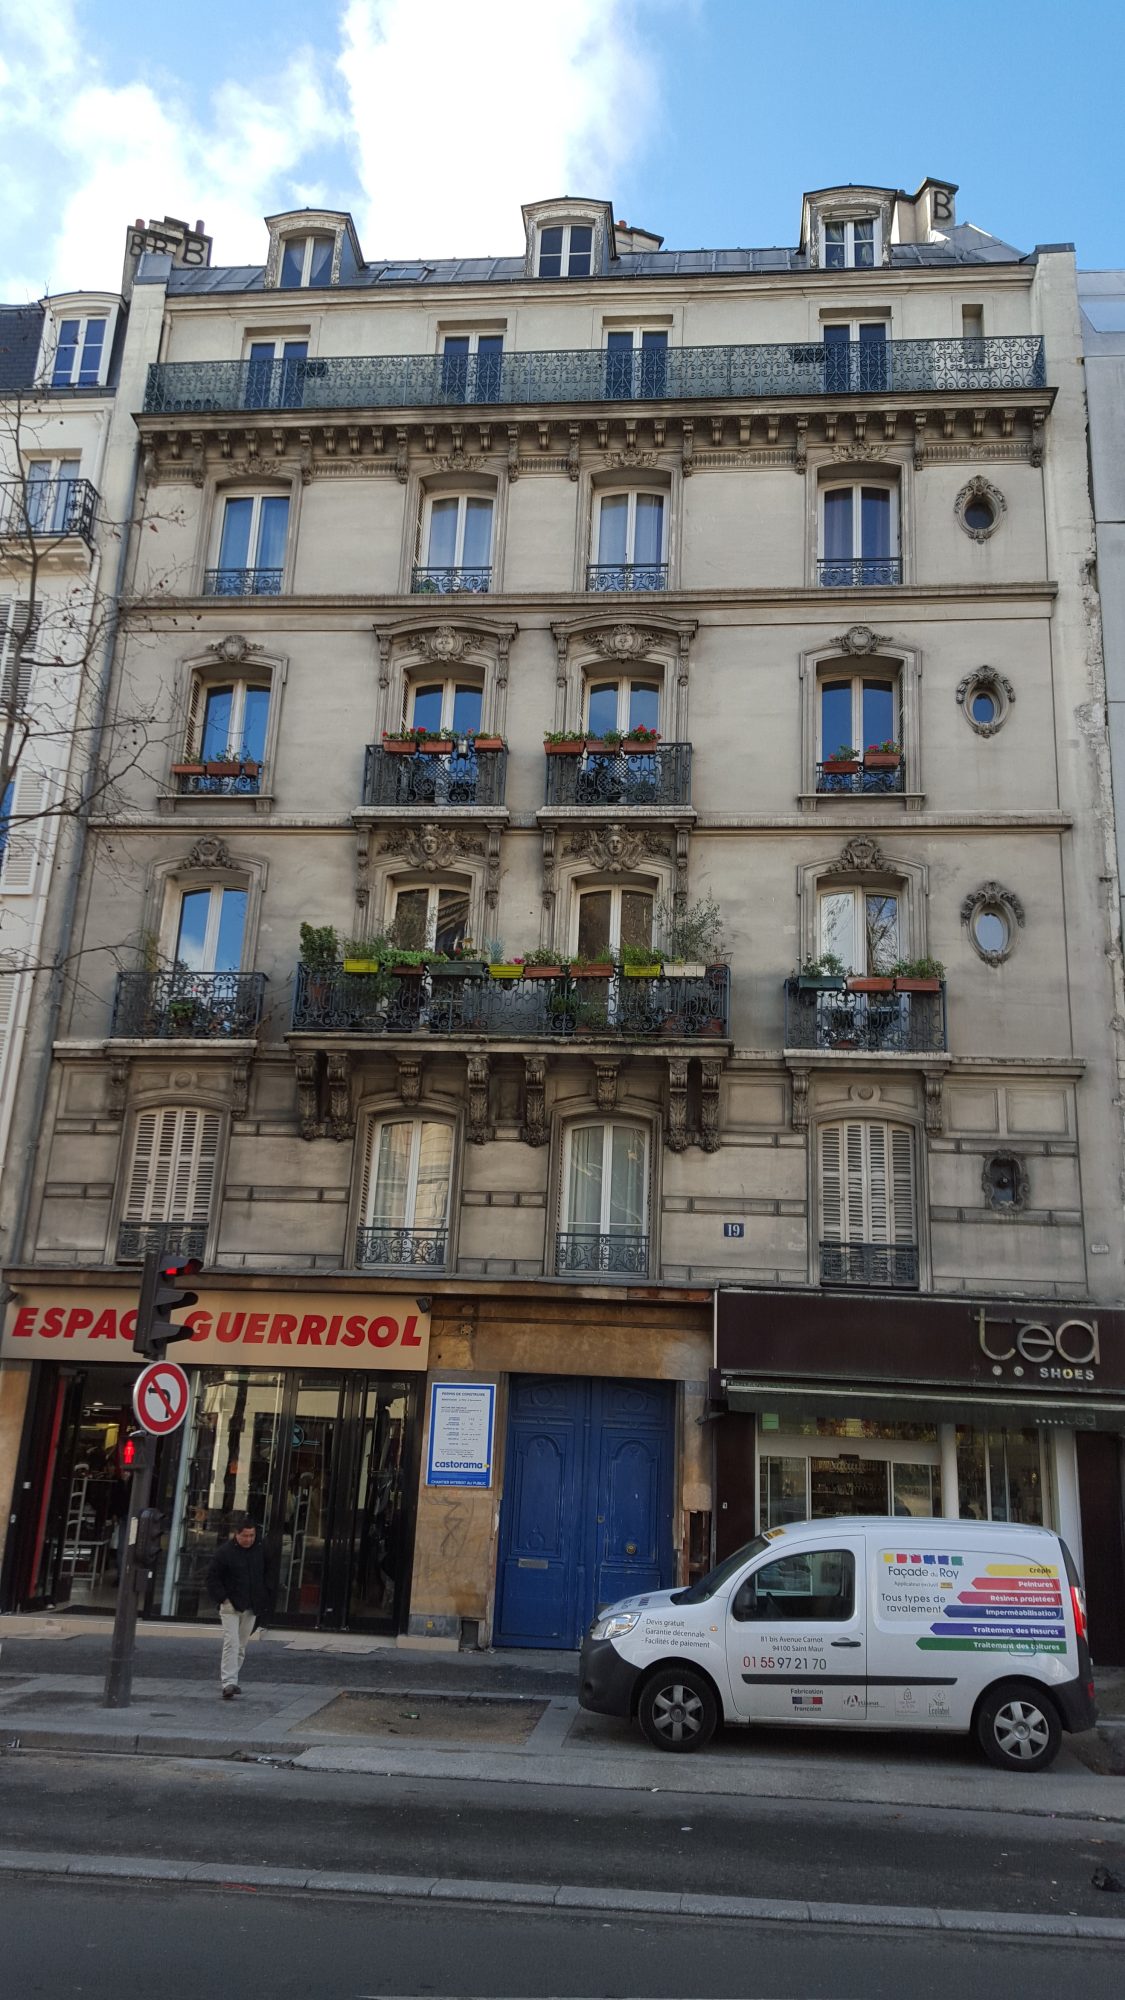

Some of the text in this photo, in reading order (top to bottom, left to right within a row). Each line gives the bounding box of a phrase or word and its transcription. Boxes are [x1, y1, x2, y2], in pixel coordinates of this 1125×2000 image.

[727, 1224, 740, 1237] 19
[12, 1307, 422, 1347] ESPAC GUERRISOL
[974, 1308, 1100, 1365] tea
[1039, 1367, 1095, 1381] SHOES
[435, 1461, 483, 1469] castorama
[888, 1566, 929, 1578] Façade
[939, 1568, 960, 1580] Roy
[1018, 1580, 1054, 1588] Peintures
[881, 1593, 946, 1604] Tous types de
[990, 1594, 1056, 1604] Résines projetées
[887, 1605, 942, 1614] ravalement
[646, 1618, 685, 1627] Devis gratuit
[645, 1628, 705, 1638] Garantie décennale
[973, 1626, 1014, 1634] Traitement
[1015, 1627, 1029, 1635] des
[670, 1638, 679, 1646] de
[679, 1639, 711, 1648] paiement
[973, 1641, 1015, 1649] Traitement
[1016, 1642, 1030, 1650] des
[743, 1656, 827, 1670] 01 55 97 21 70
